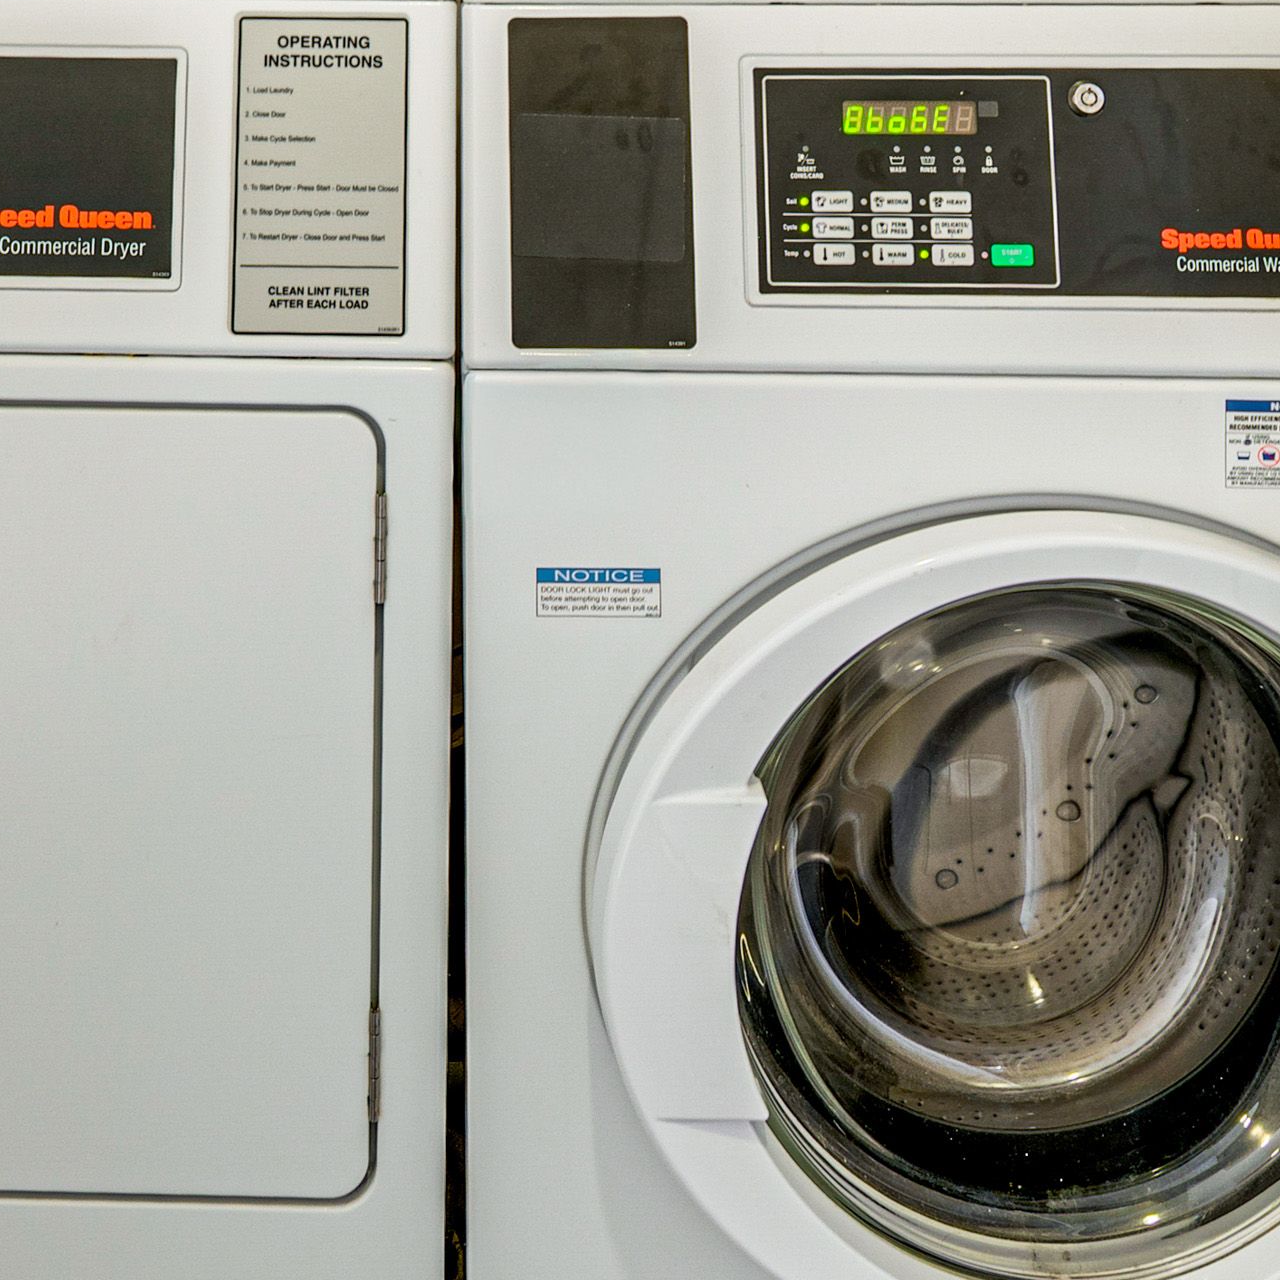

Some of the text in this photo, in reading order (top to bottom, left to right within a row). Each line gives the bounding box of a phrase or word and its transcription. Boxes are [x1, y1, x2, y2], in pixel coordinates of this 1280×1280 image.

[278, 36, 370, 48] OPERATING
[264, 54, 383, 68] INSTRUCTIONS
[59, 205, 153, 230] Queen
[1161, 228, 1242, 253] Speed
[0, 236, 146, 259] Commercial Dryer
[784, 250, 799, 258] Temp
[1177, 256, 1259, 272] Commercial
[268, 286, 369, 296] CLEAN LINT FILTER
[269, 300, 368, 309] AFTER EACH LOAD
[555, 570, 644, 582] NOTICE
